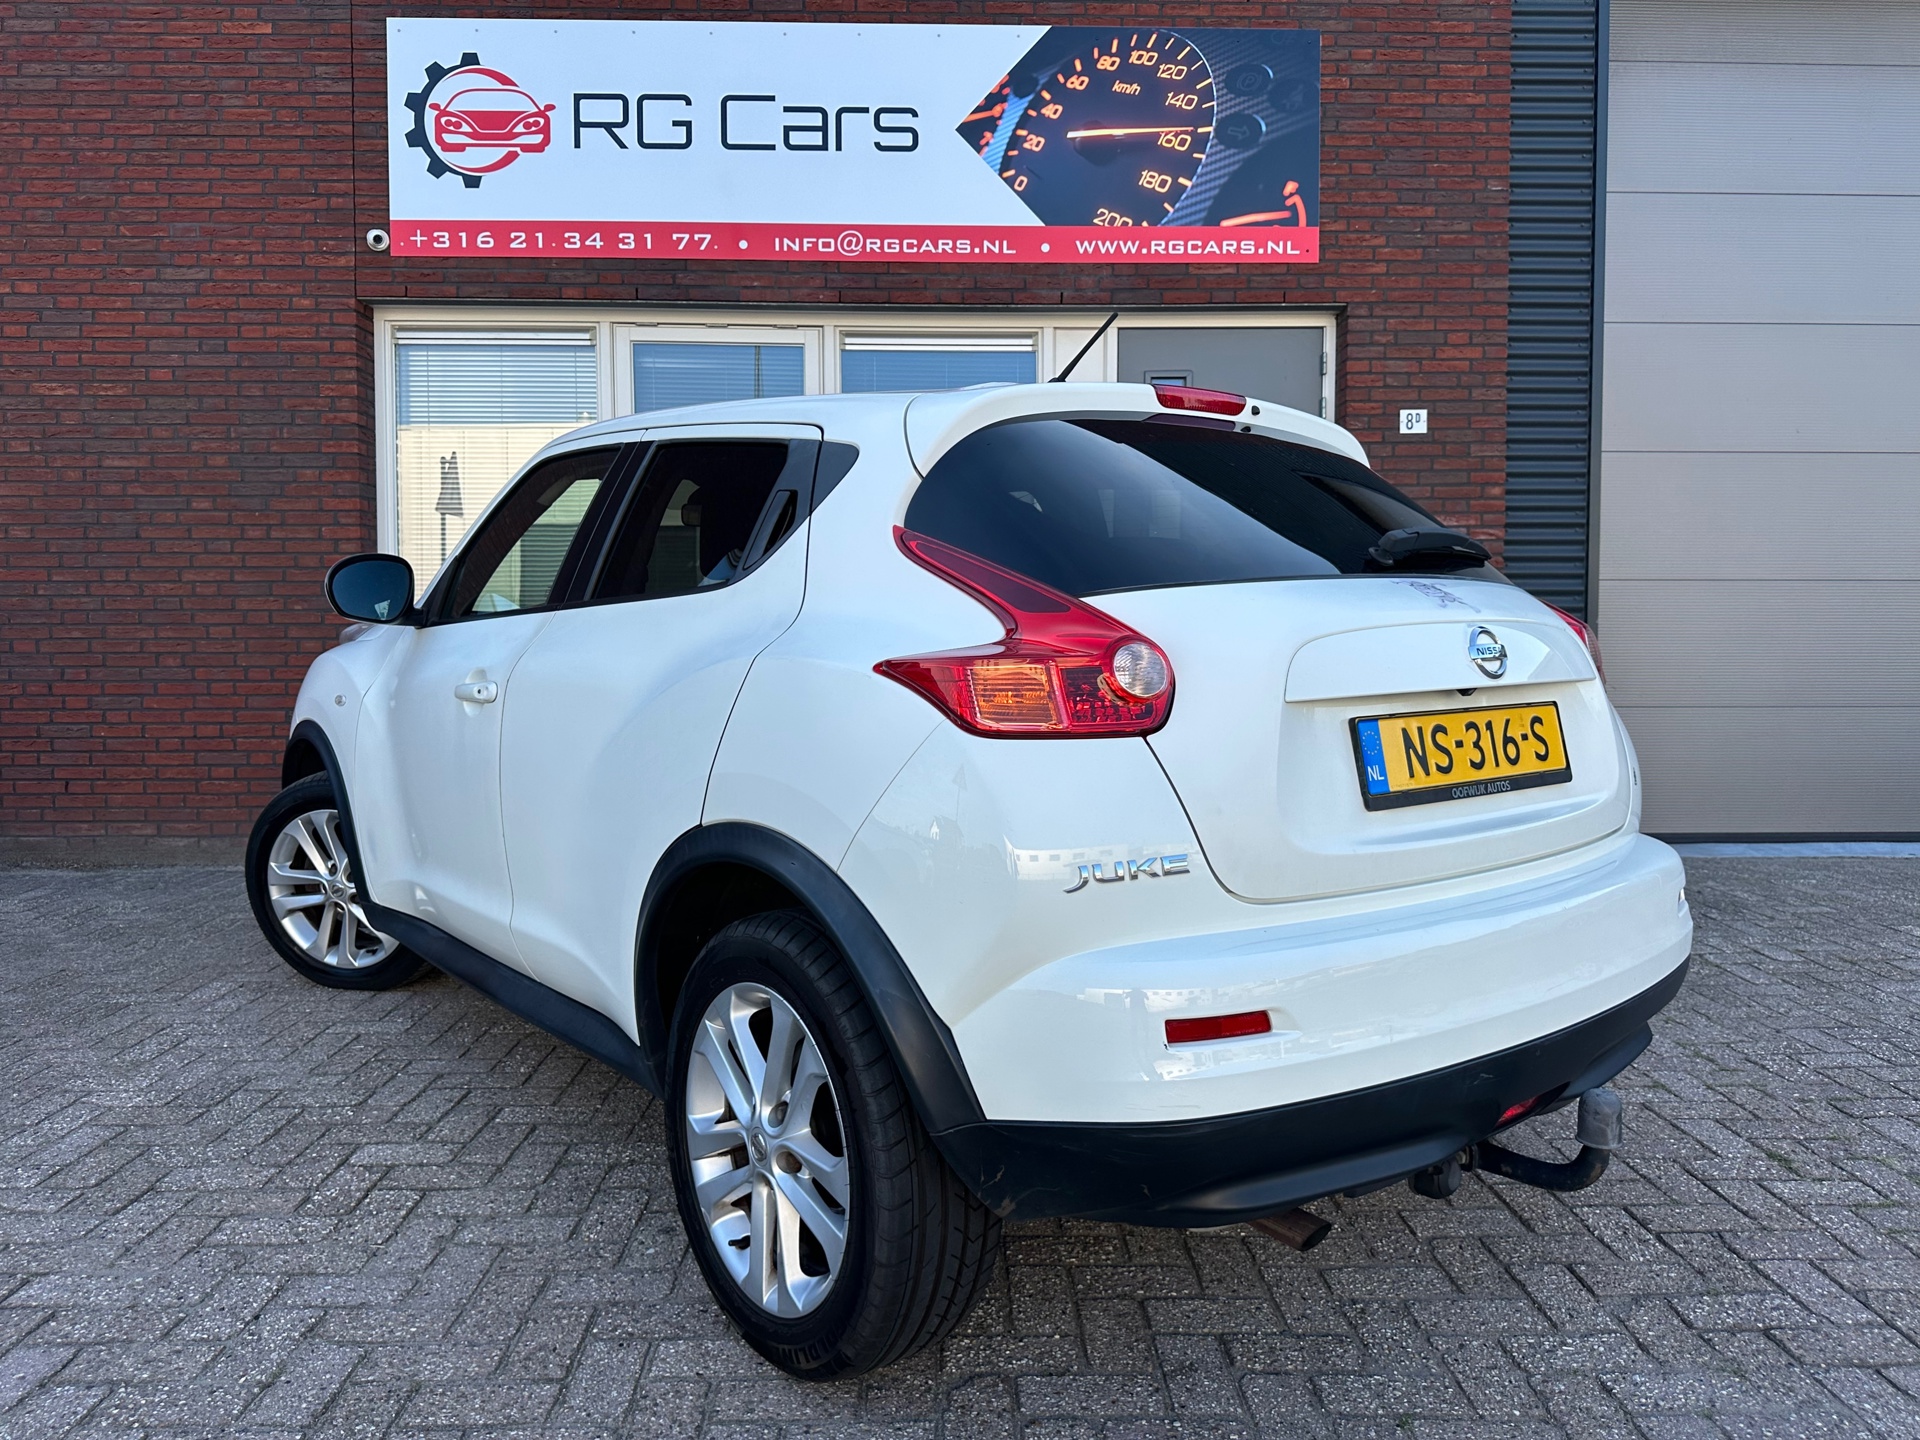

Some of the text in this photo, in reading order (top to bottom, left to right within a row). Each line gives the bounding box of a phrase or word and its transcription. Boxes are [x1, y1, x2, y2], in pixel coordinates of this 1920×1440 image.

[1096, 55, 1121, 71] 80
[1128, 49, 1159, 66] 100
[1156, 63, 1188, 80] 120
[1066, 75, 1089, 91] 60
[1111, 80, 1141, 96] km/h
[1164, 92, 1199, 110] 140
[1040, 103, 1063, 119] 40
[573, 92, 920, 153] RG Cars
[1022, 134, 1045, 152] 20
[1157, 131, 1192, 151] 160
[1013, 175, 1028, 191] 0
[1138, 169, 1172, 193] 180
[1093, 208, 1133, 227] 200
[409, 229, 495, 248] +316
[564, 231, 604, 249] 34
[618, 232, 652, 250] 31
[774, 230, 1017, 256] INFO@RGCARS.NL
[1075, 239, 1301, 255] WWW.RGCARS.NL
[1476, 646, 1504, 657] NISSA
[1401, 715, 1550, 779] NS-316-S
[1367, 765, 1385, 782] NL
[1487, 780, 1511, 793] AUTOS
[1062, 853, 1191, 894] JUKE
